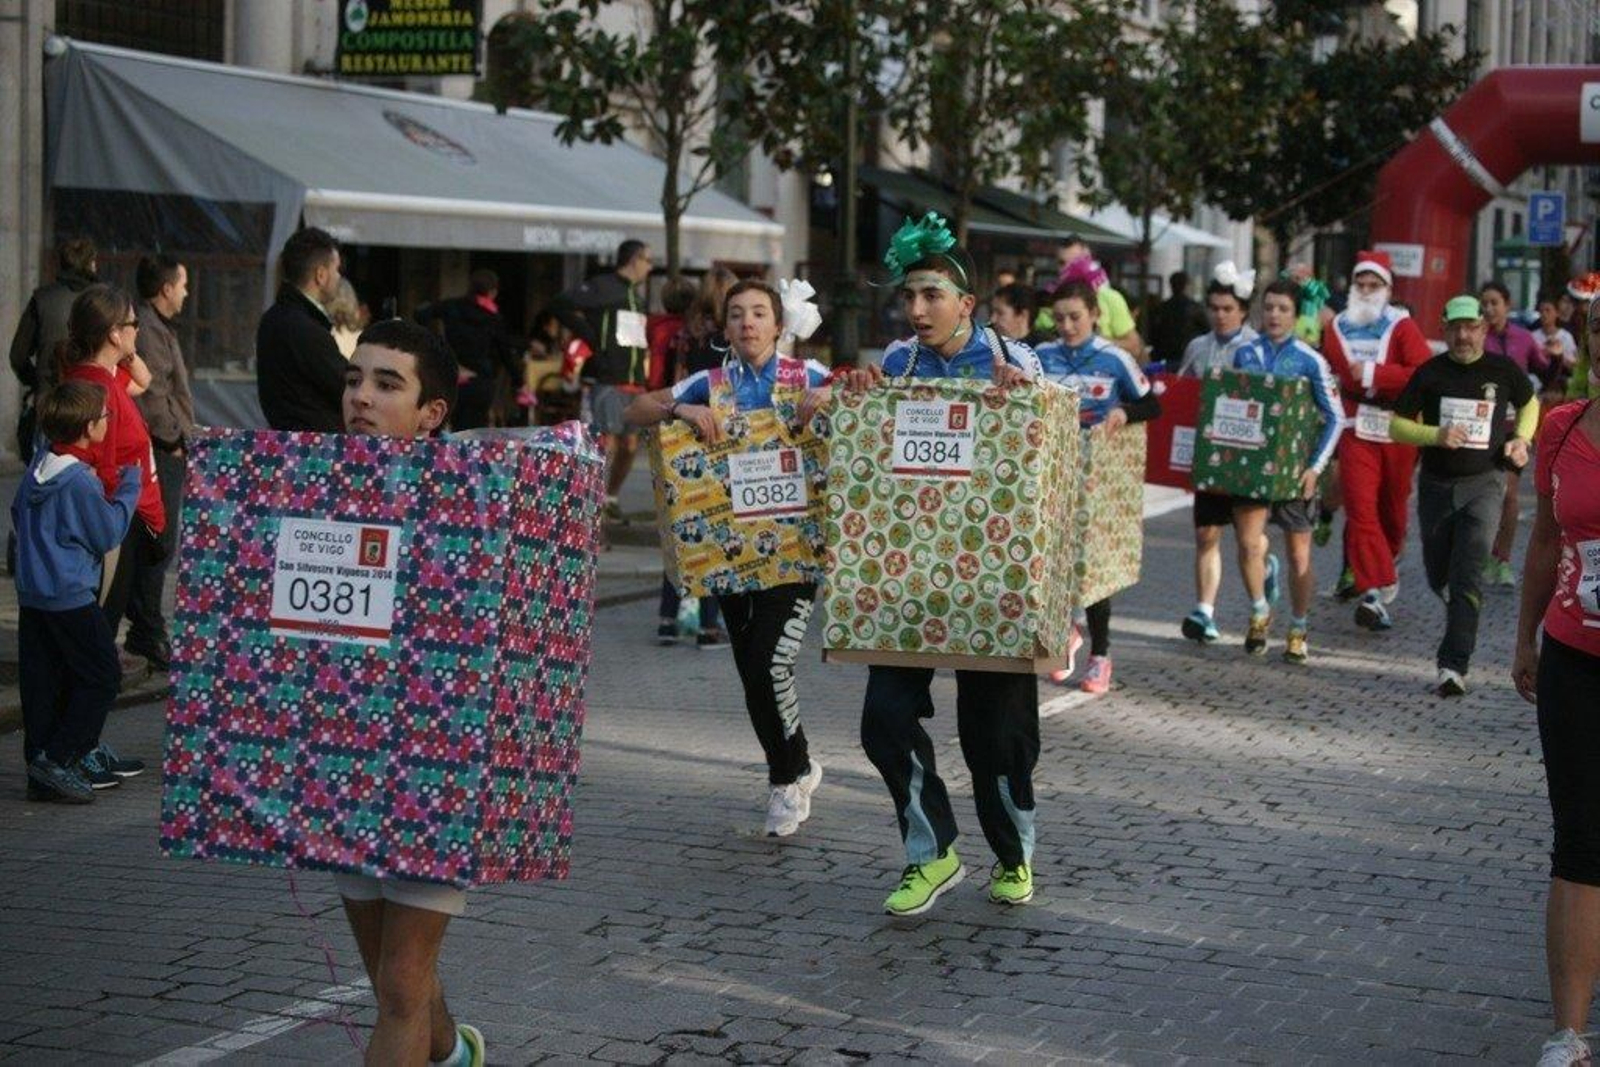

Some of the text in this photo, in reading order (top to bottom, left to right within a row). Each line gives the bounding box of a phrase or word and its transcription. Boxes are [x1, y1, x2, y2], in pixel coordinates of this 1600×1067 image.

[368, 10, 474, 26] JAMONERIA
[342, 30, 474, 50] COMPOSTELA
[341, 53, 473, 73] RESTAURANTE
[1537, 199, 1555, 220] P
[905, 408, 944, 416] CONCELLO
[922, 416, 940, 424] VIGO
[1219, 420, 1255, 438] 0386
[903, 440, 961, 463] 0384
[742, 482, 799, 507] 0382
[294, 529, 353, 544] CONCELLO
[299, 543, 345, 556] DE VIGO
[278, 560, 393, 580] San Silvestre Viguesa 2014
[289, 577, 371, 617] 0381
